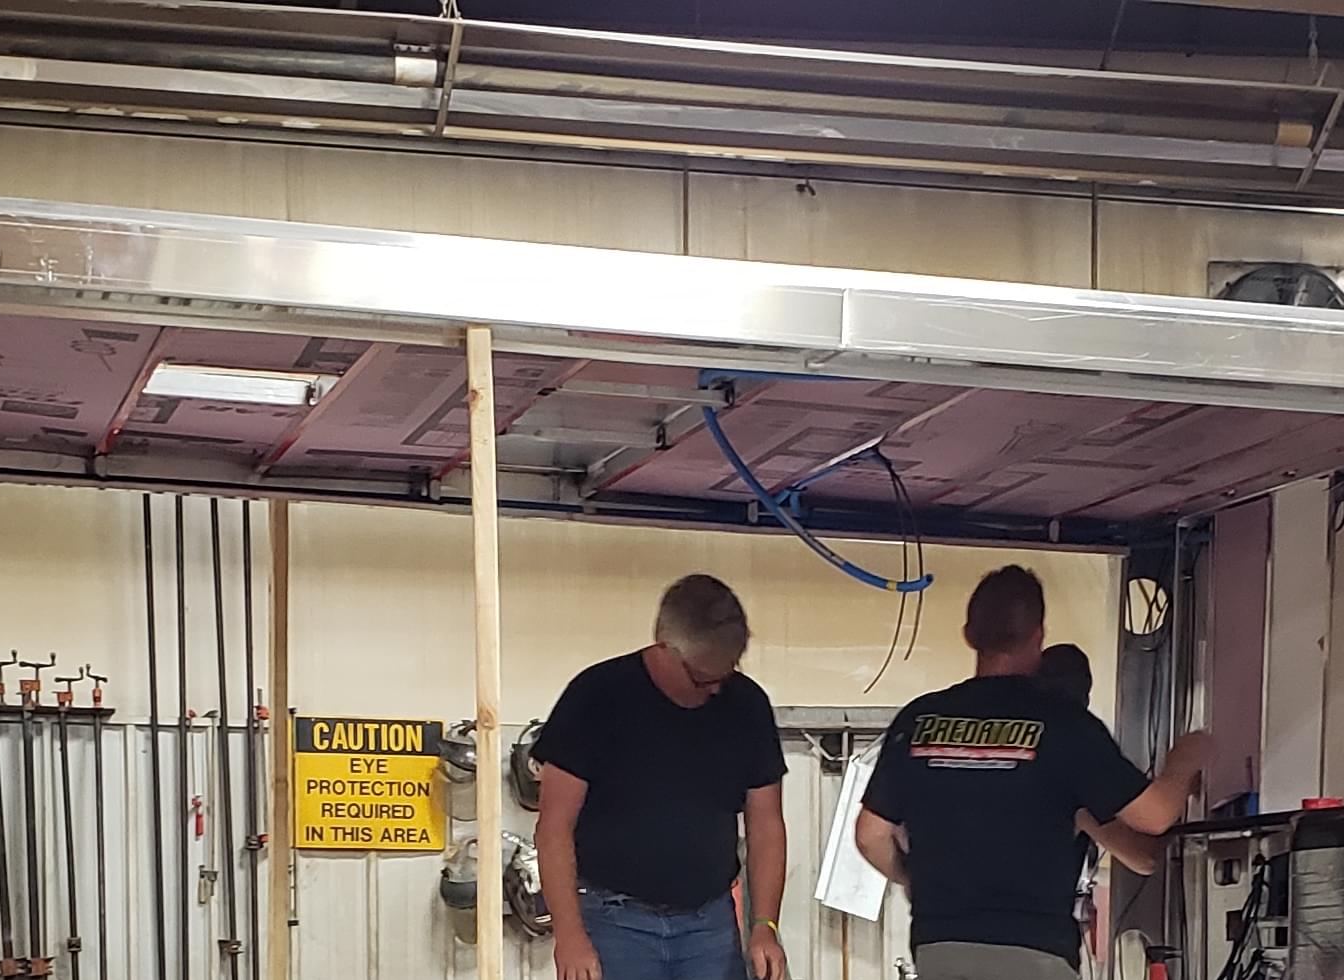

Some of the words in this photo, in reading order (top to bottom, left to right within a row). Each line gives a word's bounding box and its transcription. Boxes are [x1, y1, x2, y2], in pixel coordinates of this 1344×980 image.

[312, 722, 423, 752] CAUTION
[911, 714, 1044, 749] PREDATOR
[350, 758, 388, 774] EYE
[306, 779, 430, 797] PROTECTION
[321, 803, 415, 819] REQUIRED
[306, 826, 324, 842] IN
[330, 826, 373, 842] THIS
[380, 828, 431, 844] AREA
